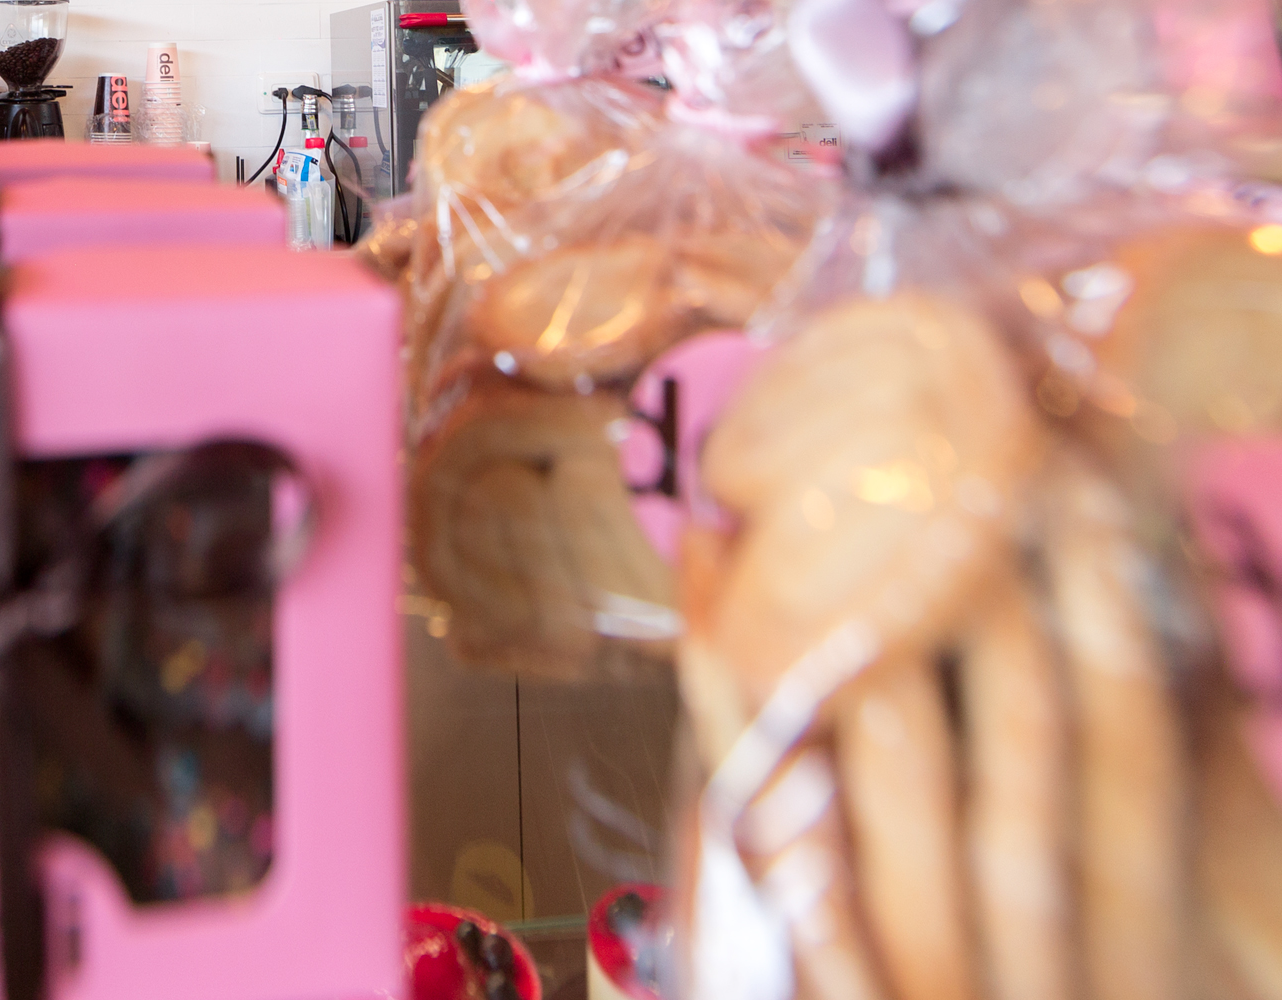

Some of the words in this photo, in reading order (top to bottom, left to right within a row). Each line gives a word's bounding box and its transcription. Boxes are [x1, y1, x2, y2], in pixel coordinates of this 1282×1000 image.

[159, 53, 174, 82] deli
[111, 76, 130, 123] deli
[819, 138, 837, 147] deli
